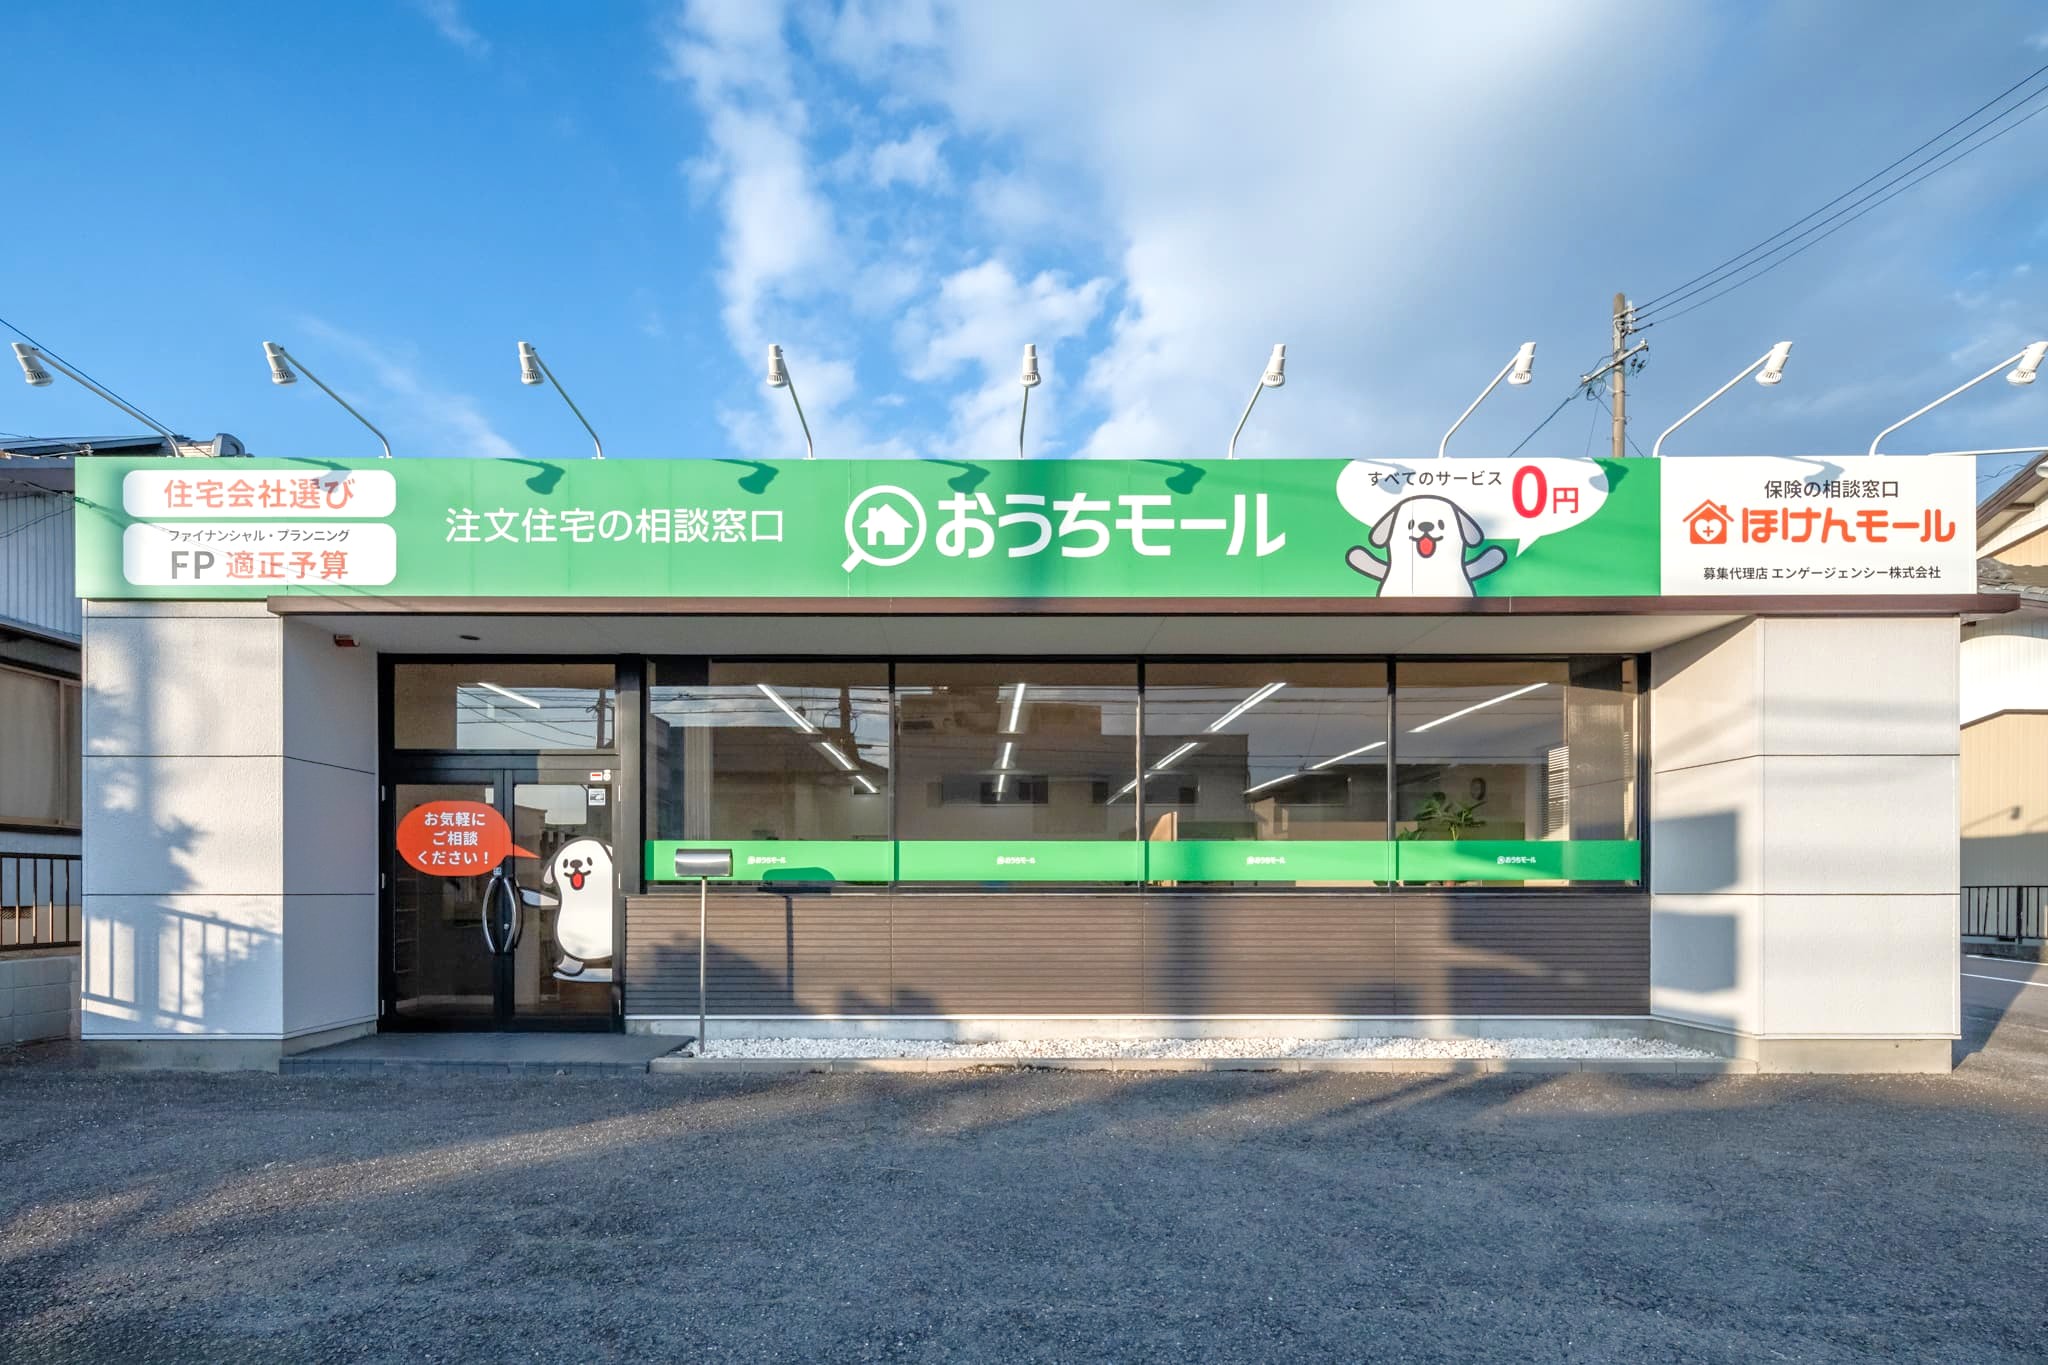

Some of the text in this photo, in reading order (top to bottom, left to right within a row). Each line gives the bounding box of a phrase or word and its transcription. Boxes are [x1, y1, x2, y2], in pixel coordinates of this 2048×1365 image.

[1367, 470, 1503, 487] すべてのサービス
[164, 477, 356, 509] 住宅会社選び
[1763, 479, 1899, 499] 保険の相談窓口
[445, 507, 784, 544] 注文住宅の相談窓口
[935, 491, 1286, 559] おうちモール
[1741, 506, 1956, 544] ほけんモール
[168, 529, 351, 543] ファイナンシャル・プランニング
[171, 550, 349, 580] FP 適正予算
[1703, 565, 1942, 580] 募集代理店 エンゲージェンシー株式会社
[424, 811, 487, 827] お気軽に
[432, 830, 479, 846] ご相談
